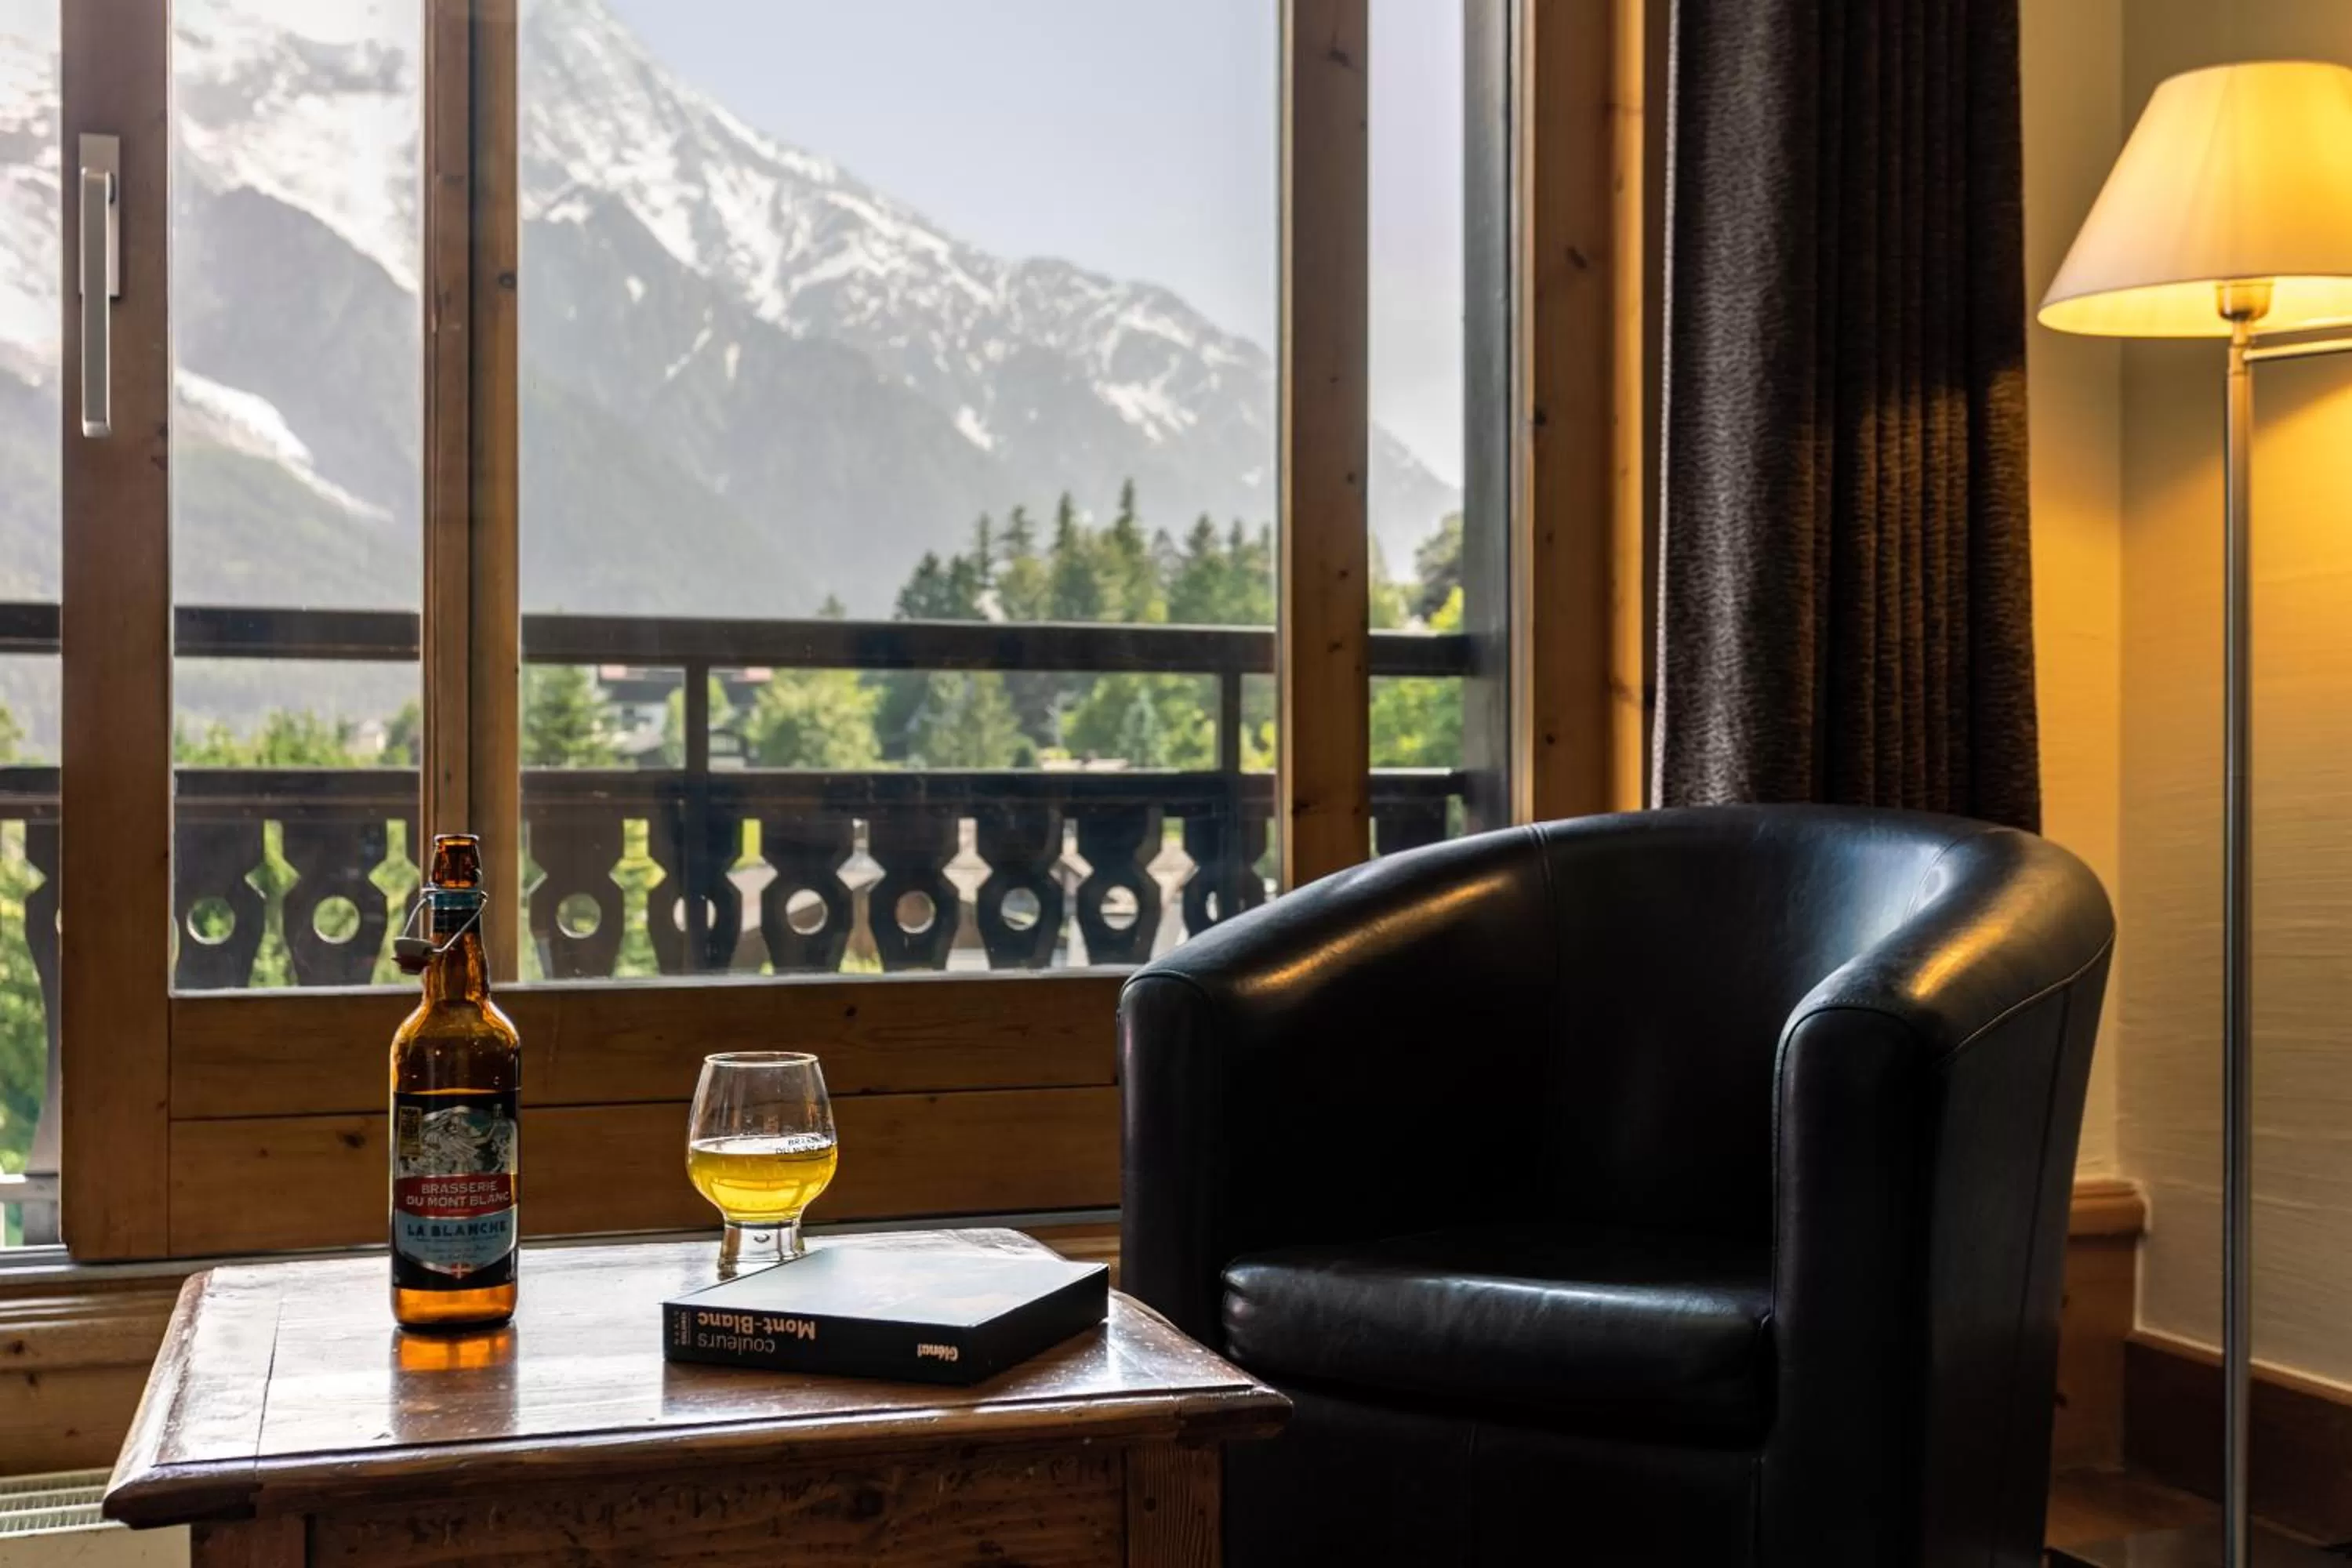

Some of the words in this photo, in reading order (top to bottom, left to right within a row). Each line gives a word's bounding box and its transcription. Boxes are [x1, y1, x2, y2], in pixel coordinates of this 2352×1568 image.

[421, 1181, 498, 1194] BRASSERIE
[406, 1195, 424, 1207] DU
[427, 1196, 466, 1207] MONT
[470, 1191, 510, 1206] BLANC
[407, 1223, 425, 1236] LA
[430, 1220, 506, 1236] BLANCHE
[697, 1311, 816, 1341] Mont-Blanc
[697, 1333, 775, 1355] couleurs
